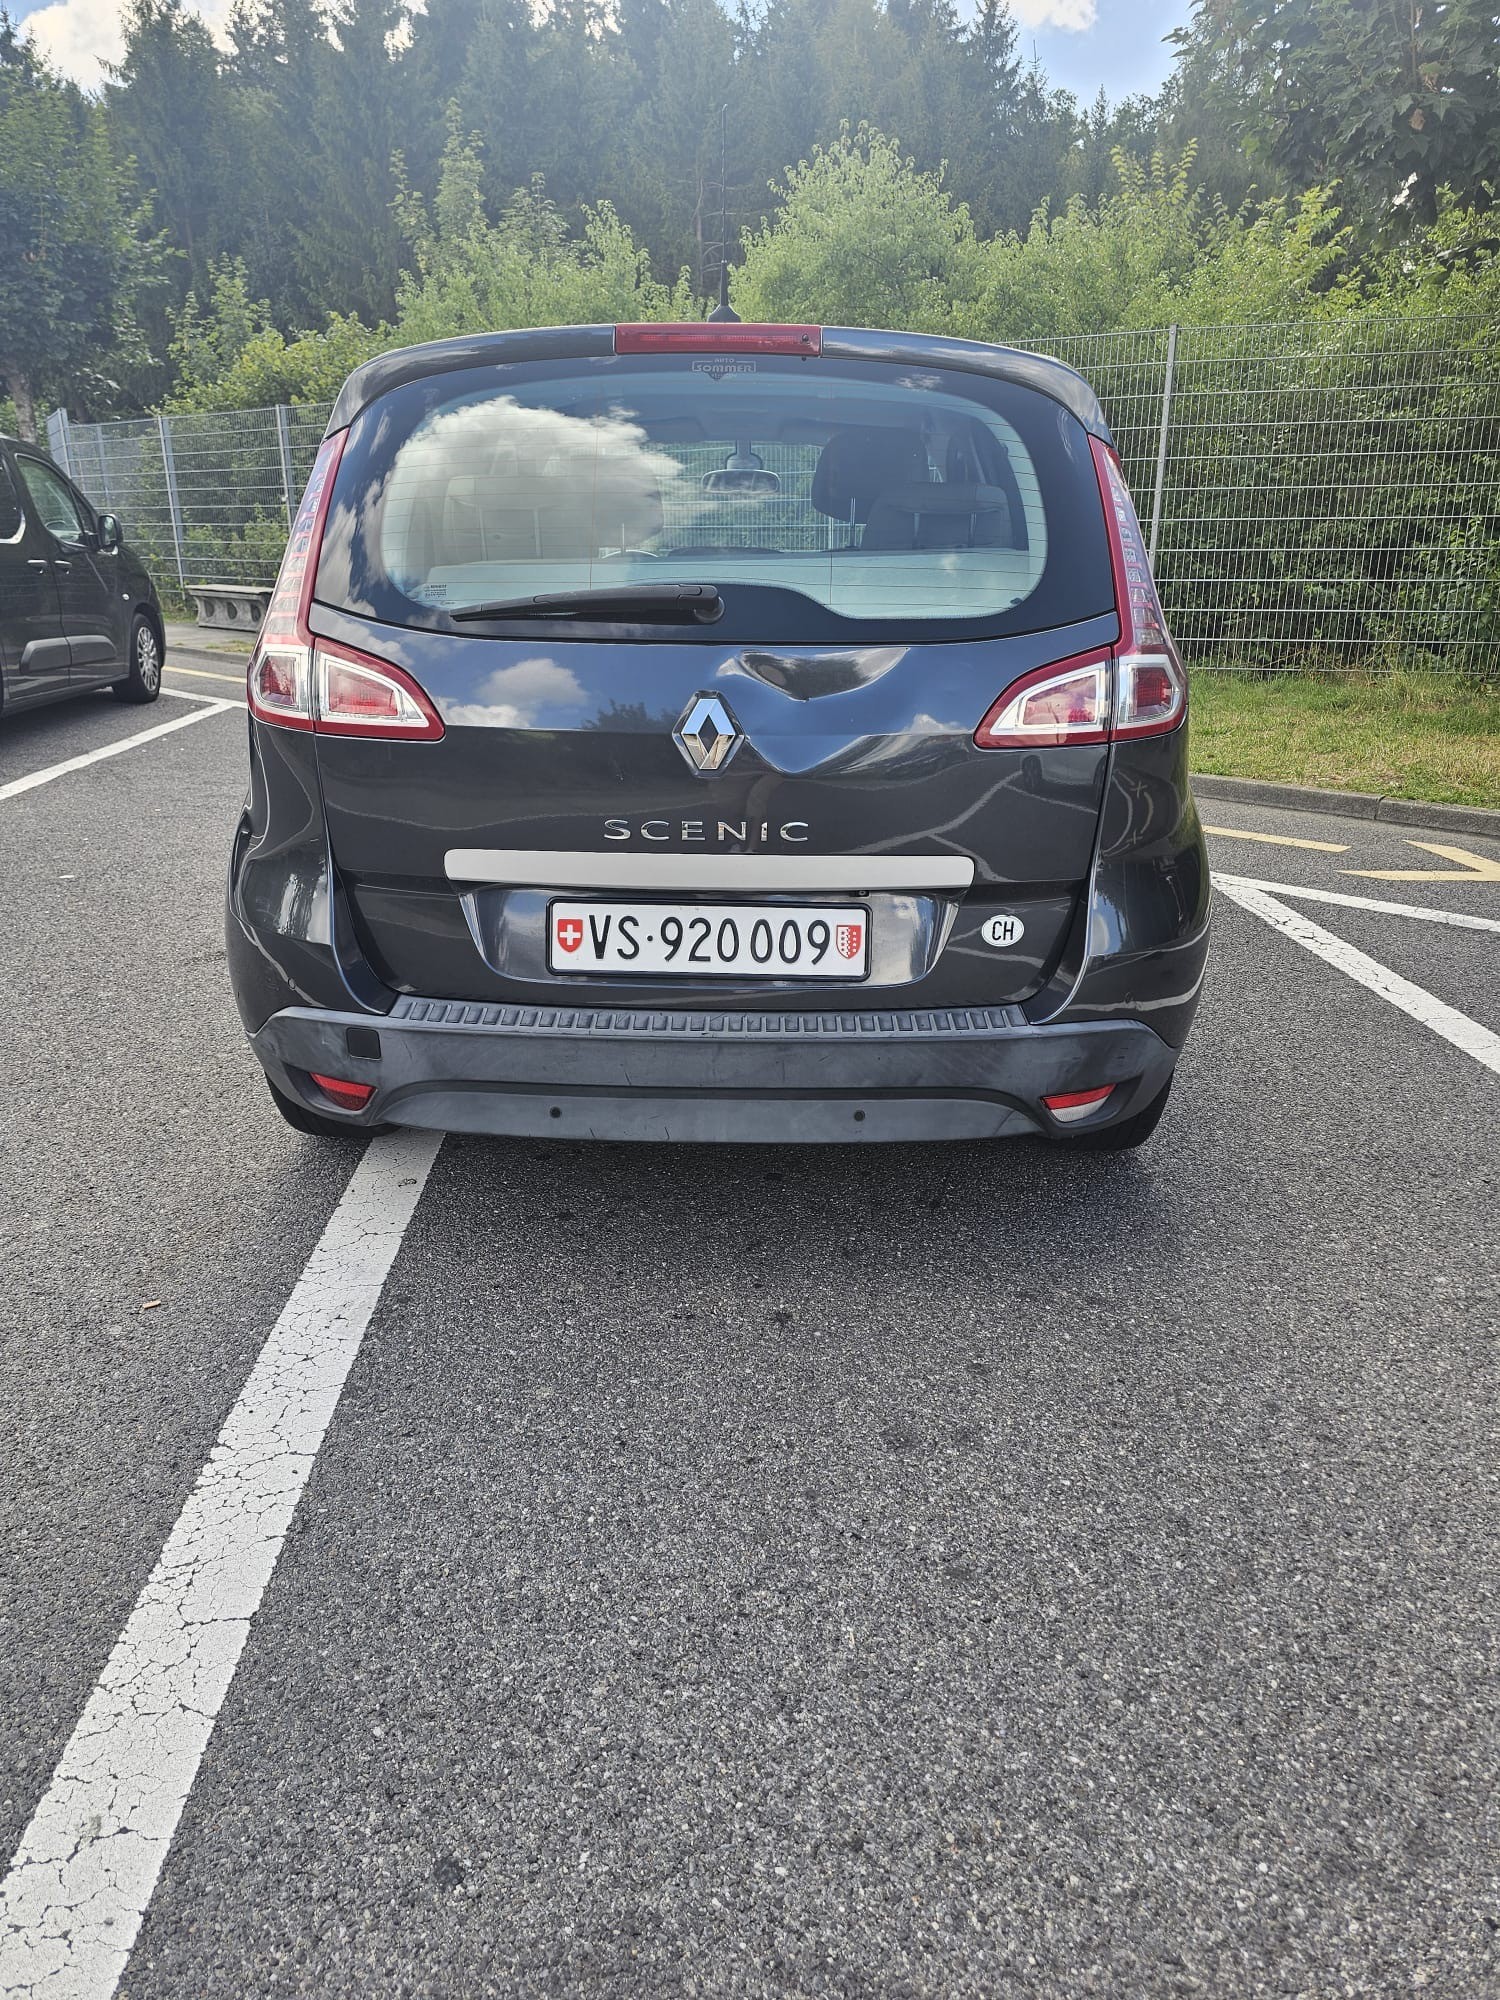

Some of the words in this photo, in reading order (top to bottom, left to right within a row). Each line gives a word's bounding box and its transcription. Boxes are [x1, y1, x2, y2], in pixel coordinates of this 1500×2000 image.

[695, 364, 752, 373] SOMMER
[603, 819, 809, 842] SCENIC
[991, 921, 1014, 940] CH
